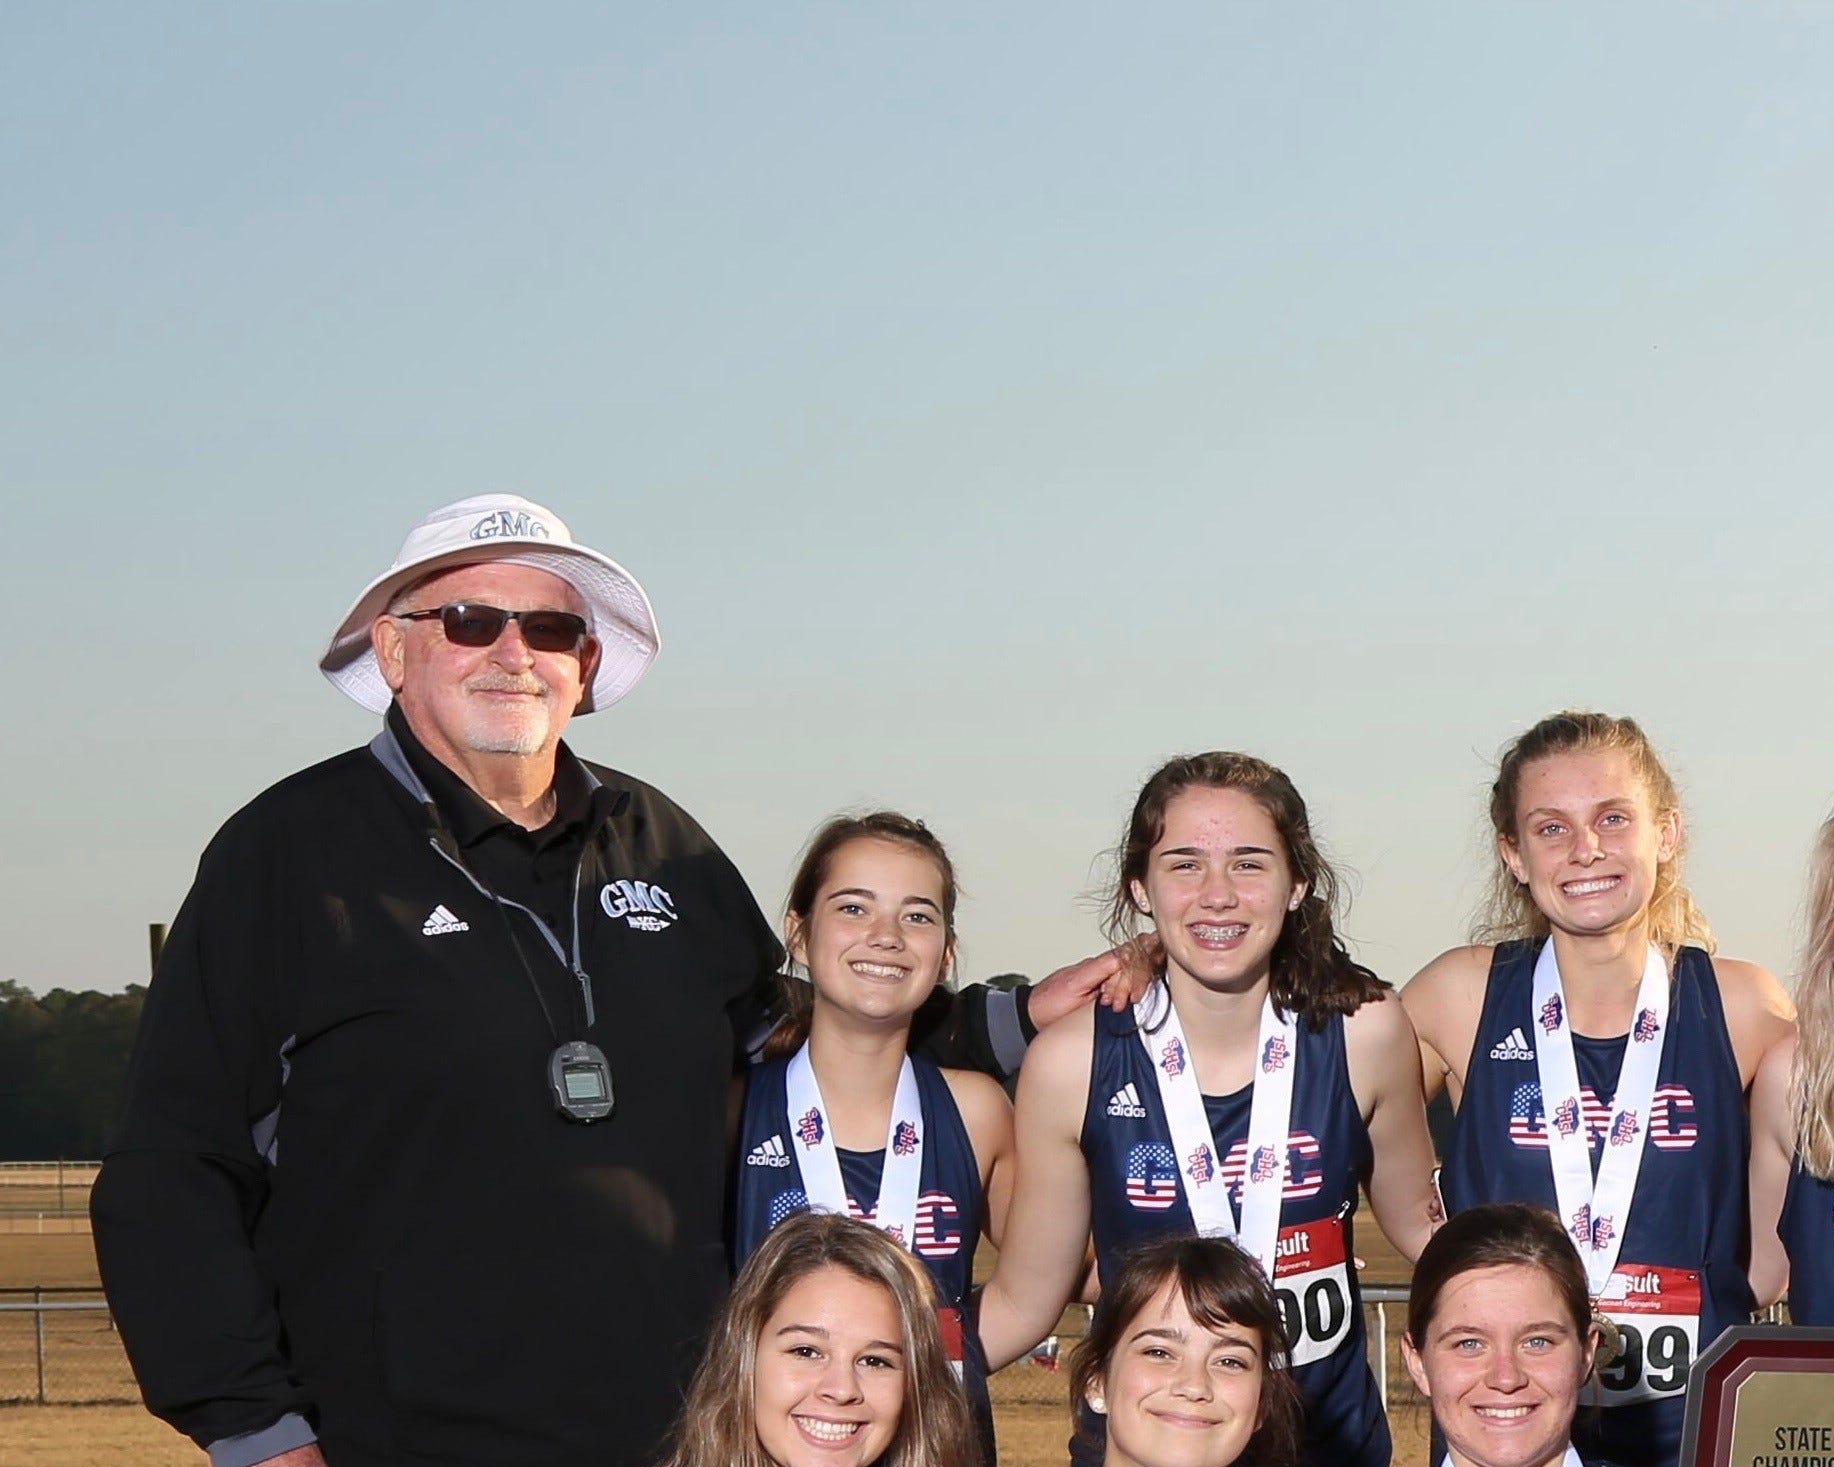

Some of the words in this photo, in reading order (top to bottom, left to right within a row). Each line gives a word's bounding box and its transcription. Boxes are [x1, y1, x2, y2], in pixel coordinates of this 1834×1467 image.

[600, 880, 679, 919] GMC
[422, 921, 470, 936] adidas
[1489, 1048, 1535, 1061] adidas
[1106, 1105, 1147, 1118] adidas
[1775, 1427, 1832, 1451] STATE
